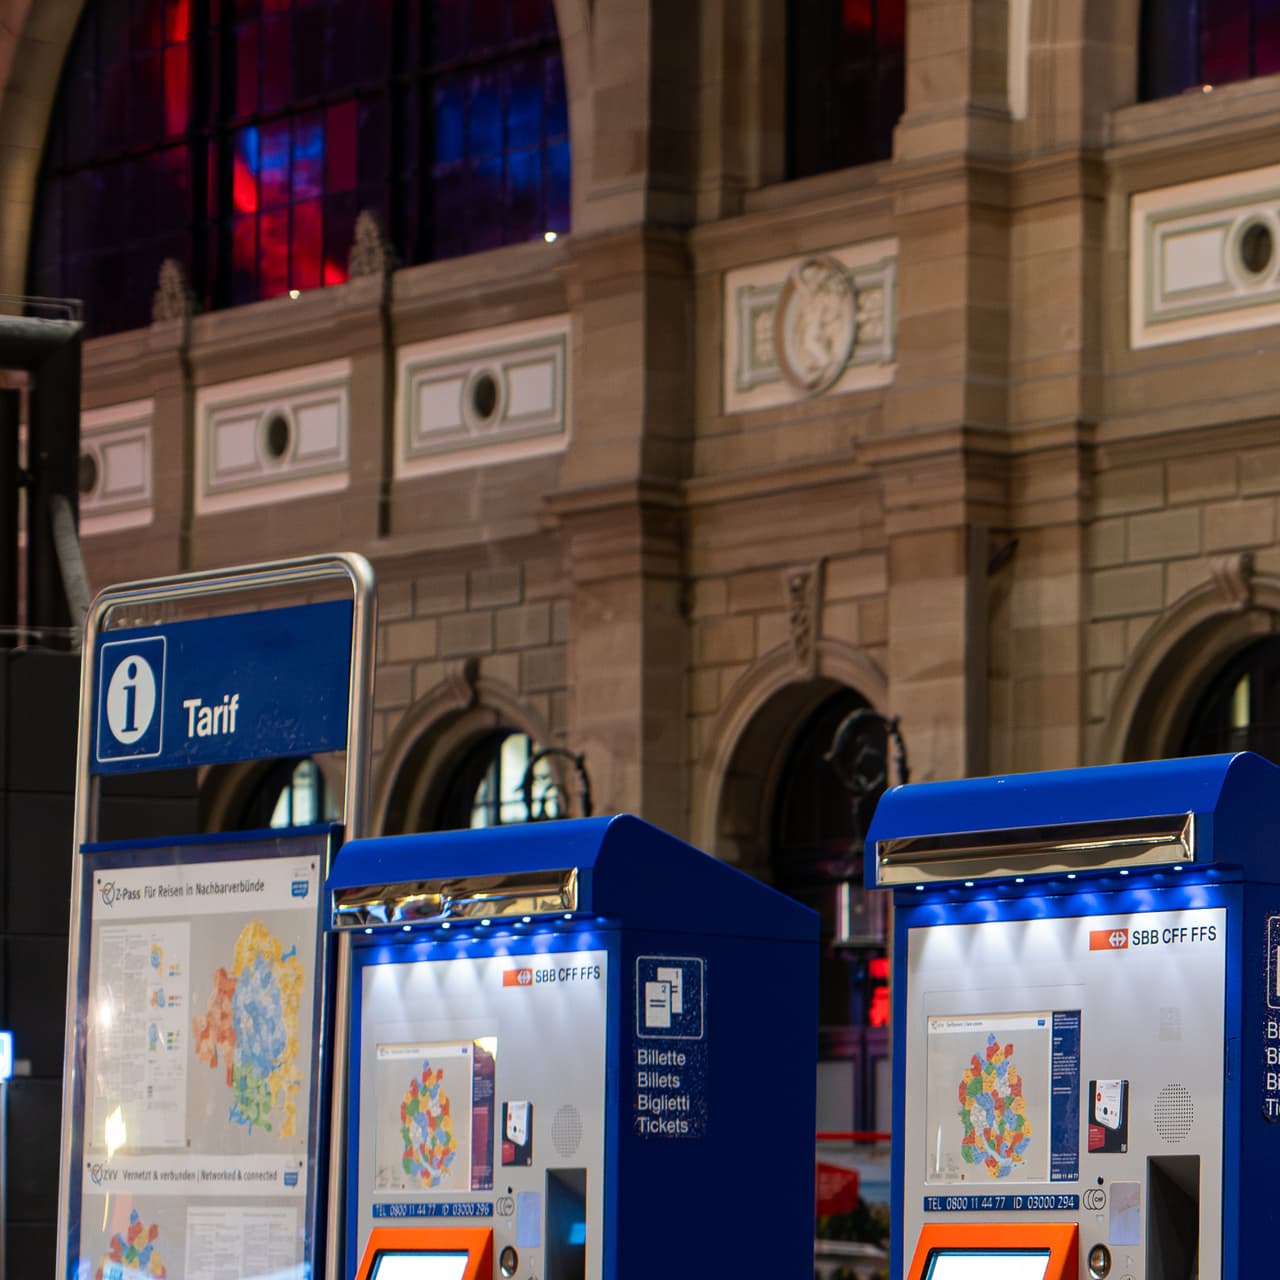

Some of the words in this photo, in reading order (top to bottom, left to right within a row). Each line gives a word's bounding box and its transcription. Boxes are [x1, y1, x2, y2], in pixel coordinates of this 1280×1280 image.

[183, 694, 239, 738] Tarif
[116, 888, 140, 900] Z-Pass
[144, 886, 155, 898] Für
[159, 884, 183, 897] Reisen
[186, 883, 193, 895] in
[196, 880, 264, 895] Nachbarverbünde
[1132, 930, 1158, 945] SBB
[1163, 928, 1187, 943] CFF
[1192, 926, 1216, 942] FFS
[536, 969, 556, 983] SBB
[559, 968, 577, 981] CFF
[581, 966, 600, 980] FFS
[638, 1049, 686, 1065] Billette
[638, 1072, 680, 1088] Billets
[638, 1094, 690, 1114] Biglietti
[638, 1117, 688, 1133] Tickets
[103, 1170, 117, 1181] ZVV
[123, 1170, 150, 1180] Vernetzt
[161, 1169, 195, 1180] verbunden
[201, 1170, 235, 1181] Networked
[244, 1170, 277, 1181] connected
[928, 1198, 941, 1209] TEL
[947, 1198, 967, 1209] 0800
[972, 1198, 978, 1208] 11
[981, 1198, 992, 1208] 44
[995, 1197, 1006, 1208] 77
[1013, 1197, 1022, 1208] ID
[1028, 1197, 1055, 1208] 03000
[1058, 1196, 1074, 1208] 294
